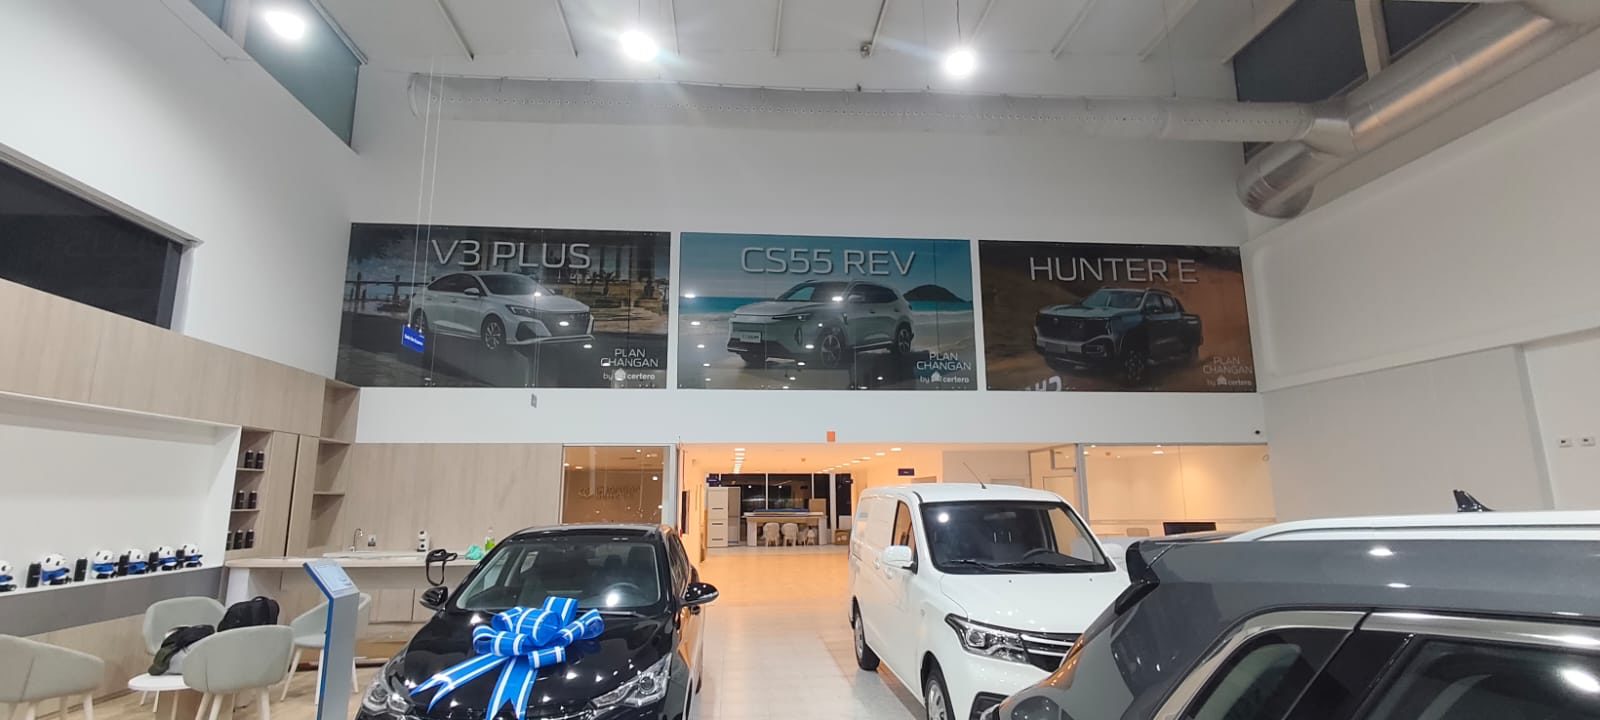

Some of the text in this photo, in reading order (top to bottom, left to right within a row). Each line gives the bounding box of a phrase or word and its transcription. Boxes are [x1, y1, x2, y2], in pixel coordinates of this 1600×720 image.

[431, 239, 591, 269] V3 PLUS
[741, 246, 917, 277] CS55 REV
[1029, 256, 1198, 283] HUNTER E
[615, 348, 646, 357] PLAN
[929, 351, 958, 360] PLAN
[600, 358, 659, 367] CHANGAN
[1213, 355, 1240, 364] PLAN
[916, 361, 972, 370] CHANGAN
[1202, 365, 1253, 374] CHANGAN
[602, 372, 656, 381] by certero
[920, 375, 970, 384] by certero
